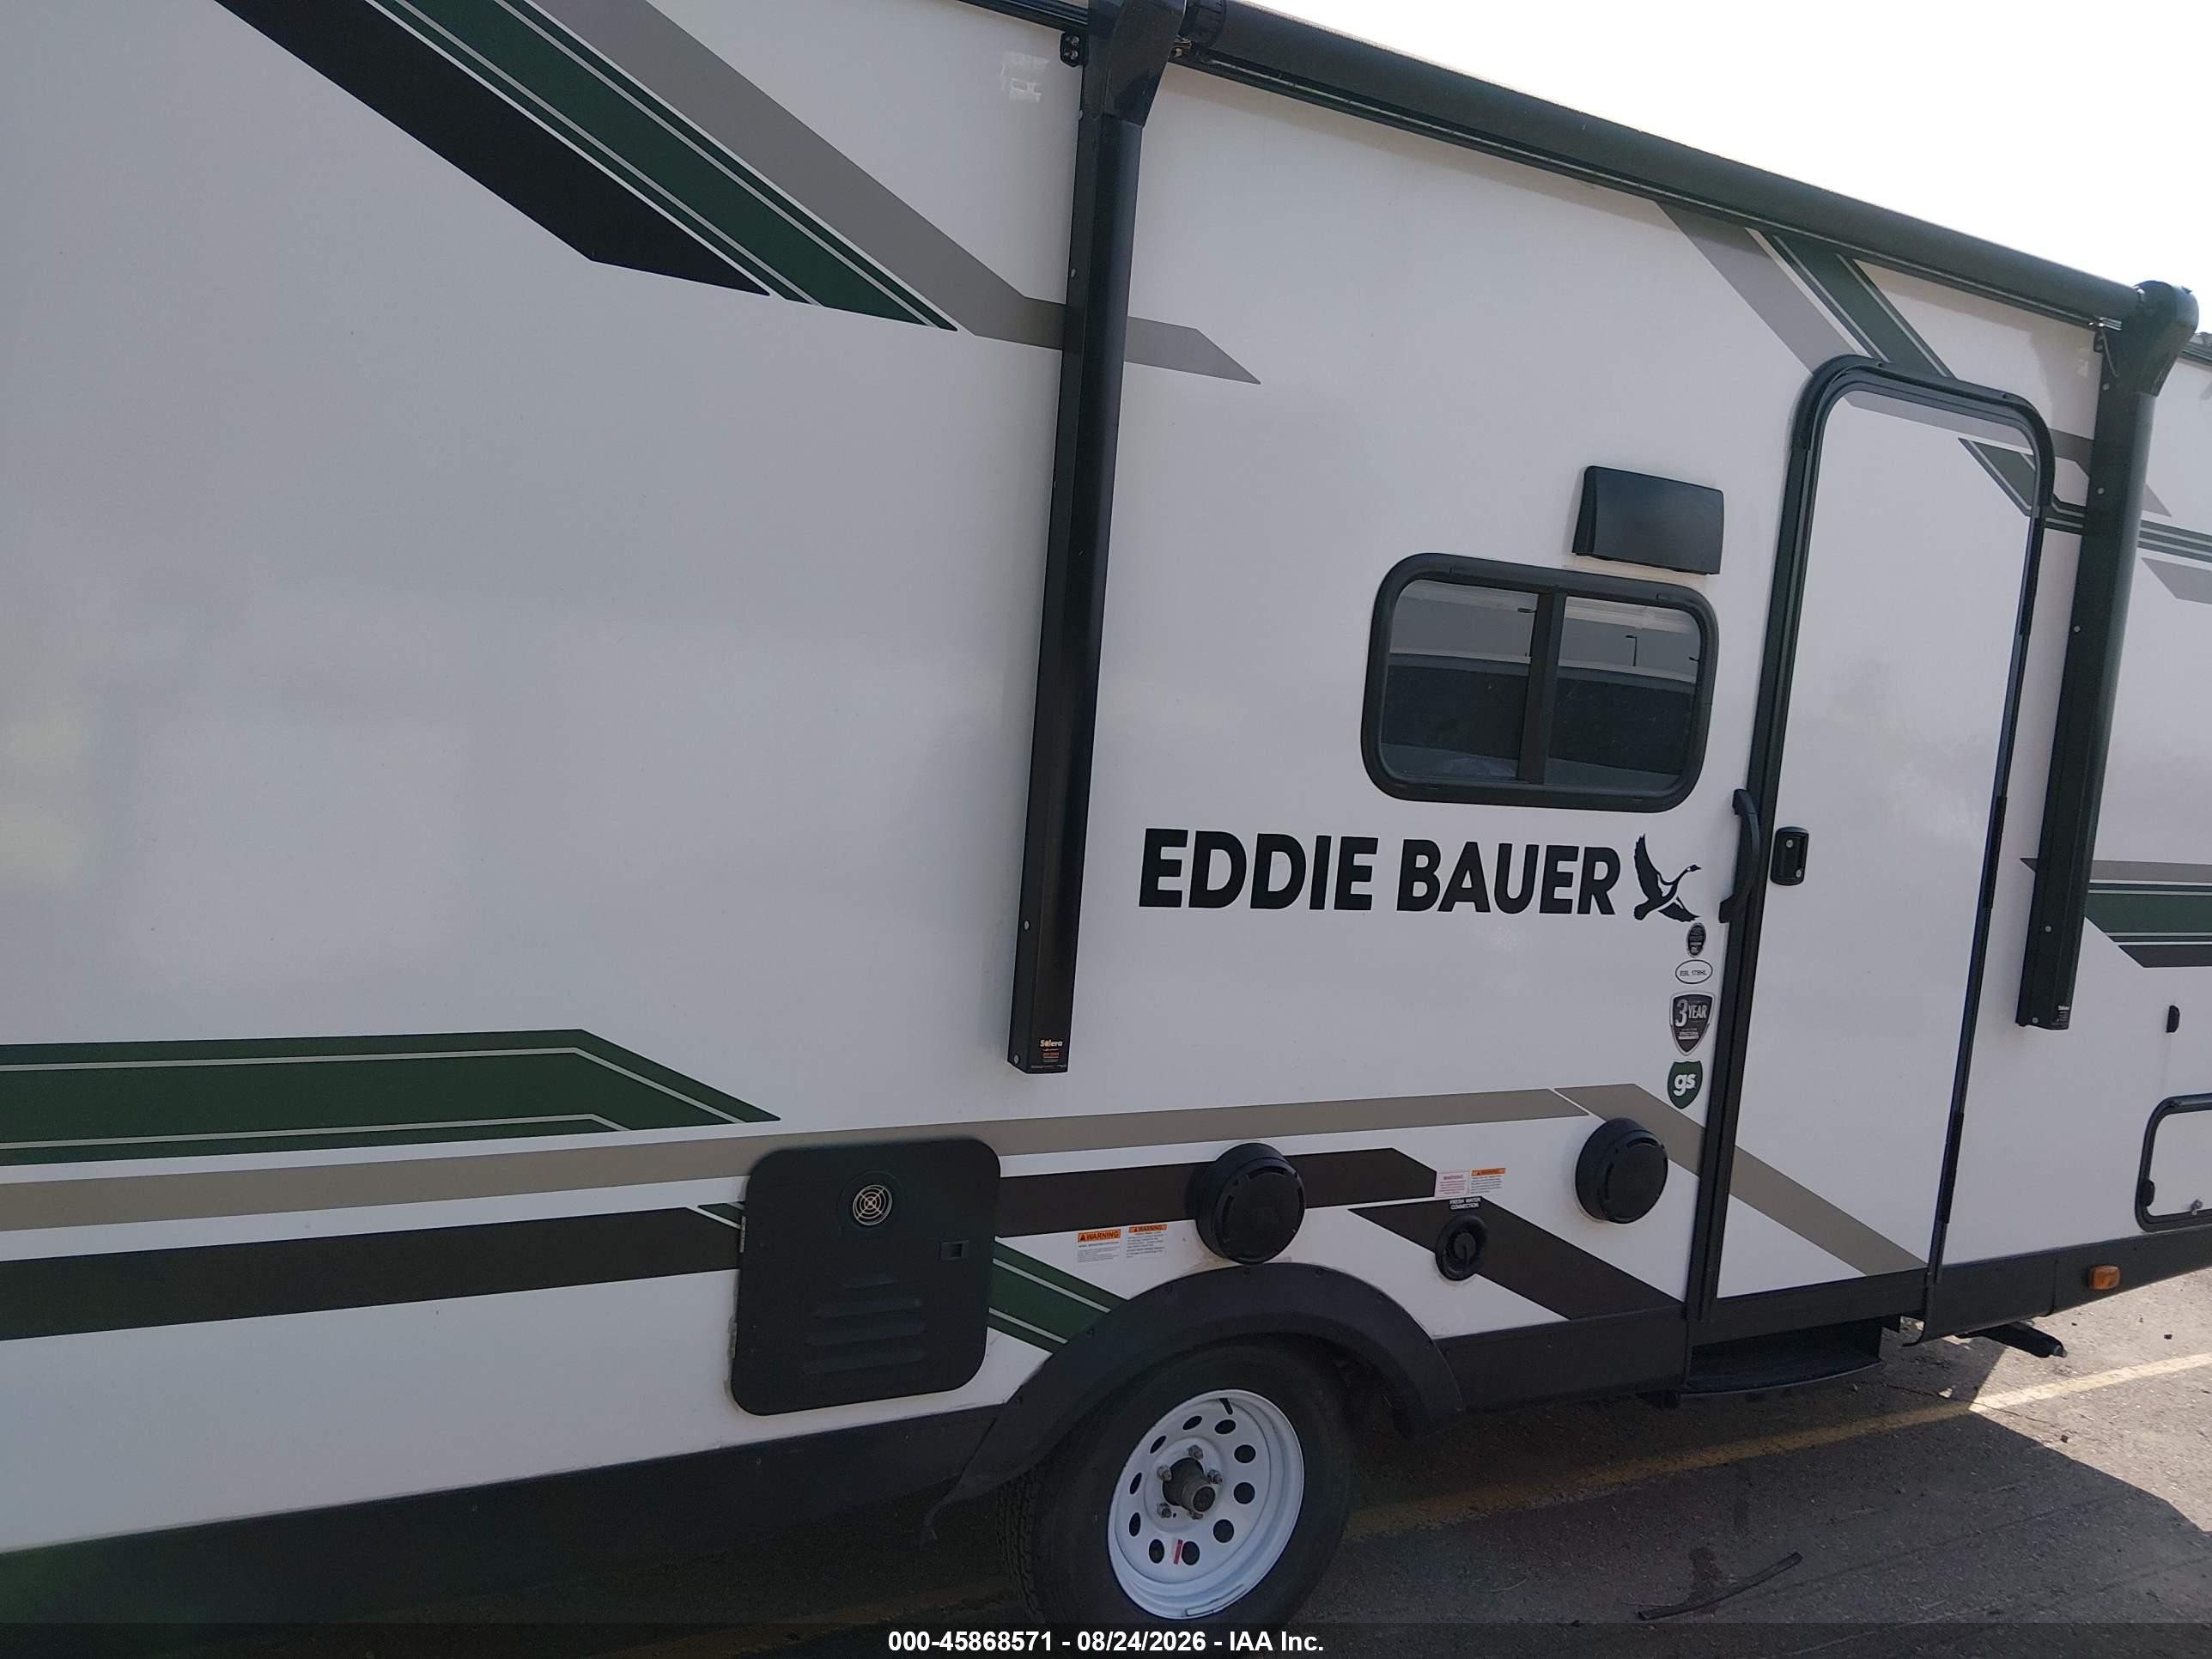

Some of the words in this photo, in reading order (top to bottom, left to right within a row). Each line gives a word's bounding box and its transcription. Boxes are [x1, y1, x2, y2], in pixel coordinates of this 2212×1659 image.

[1139, 827, 1379, 911] EDDIE
[1396, 838, 1621, 915] BAUER
[1674, 999, 1688, 1027] 3
[1688, 1005, 1707, 1018] YEAR
[1673, 1073, 1697, 1097] gs
[1086, 1231, 1119, 1240] WARNING
